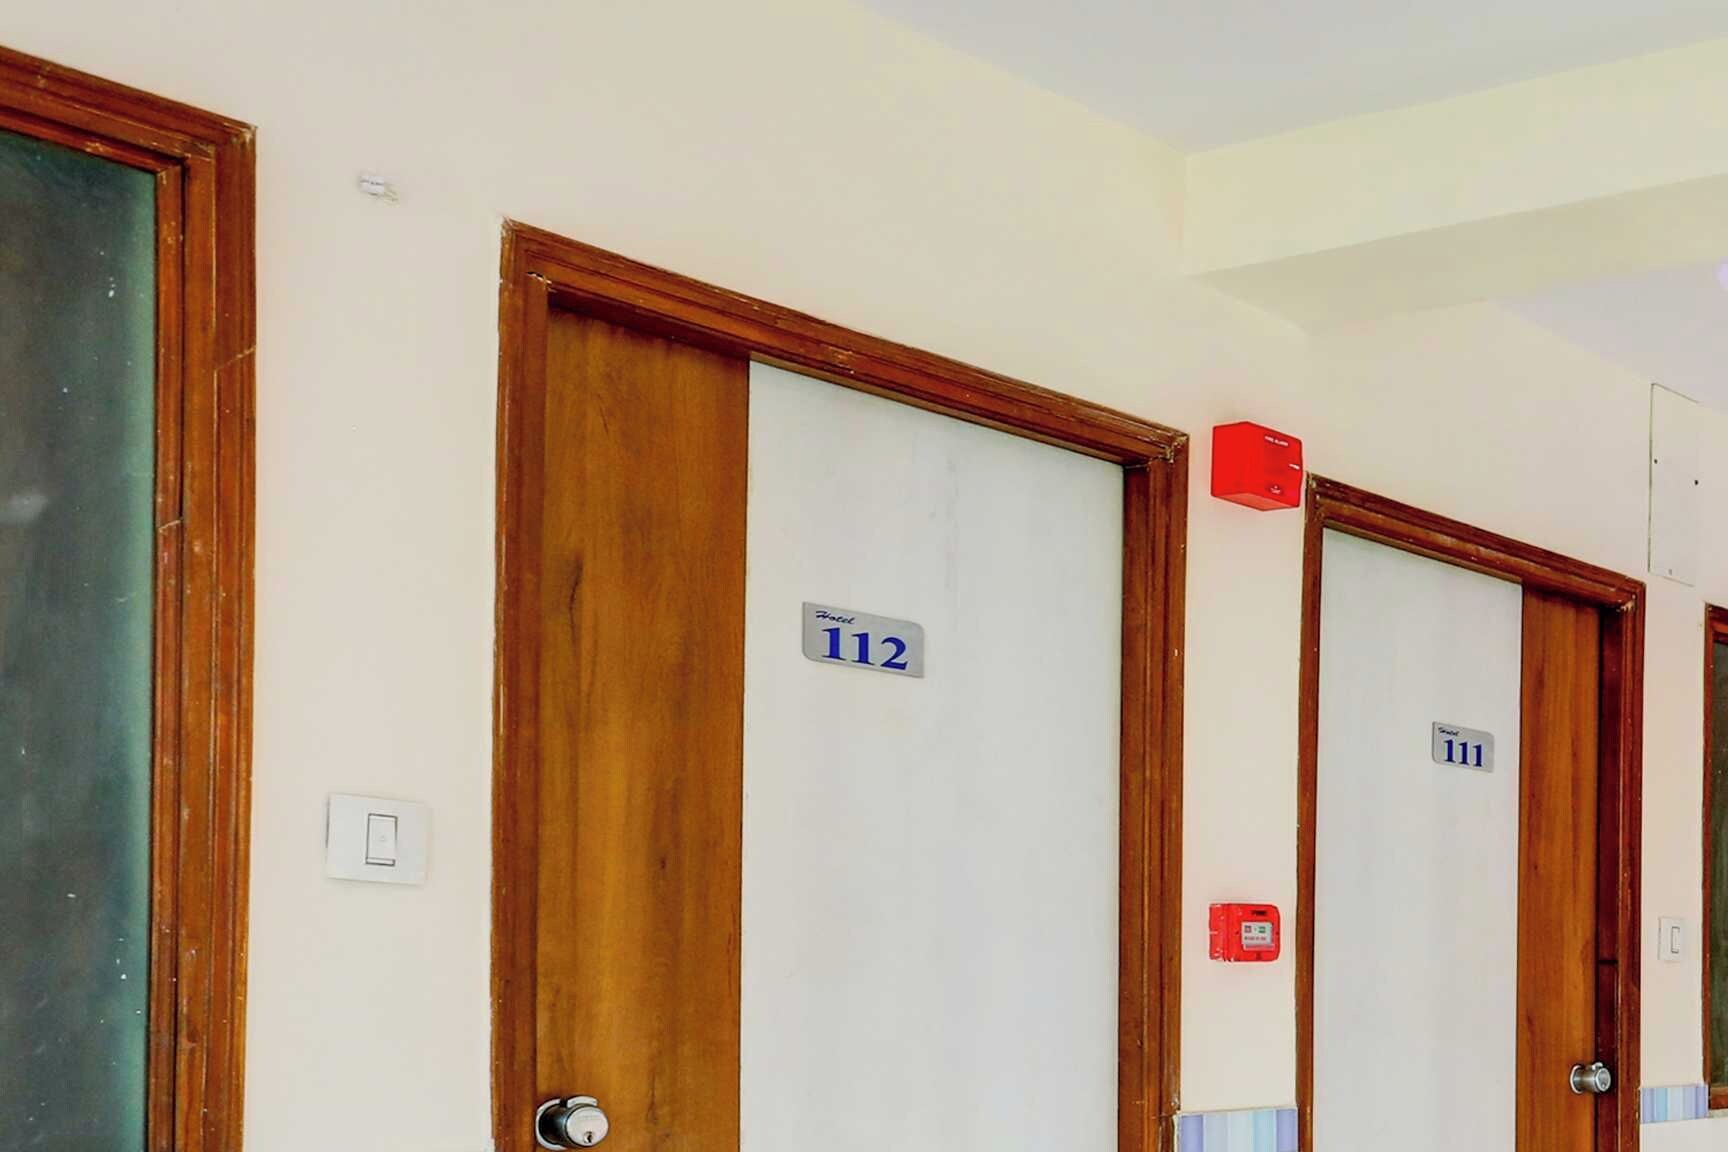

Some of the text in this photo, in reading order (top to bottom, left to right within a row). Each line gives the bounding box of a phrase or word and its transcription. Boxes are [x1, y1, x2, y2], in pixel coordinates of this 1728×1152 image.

[815, 610, 855, 624] Hotel
[821, 627, 908, 670] 112
[1443, 739, 1483, 767] 111
